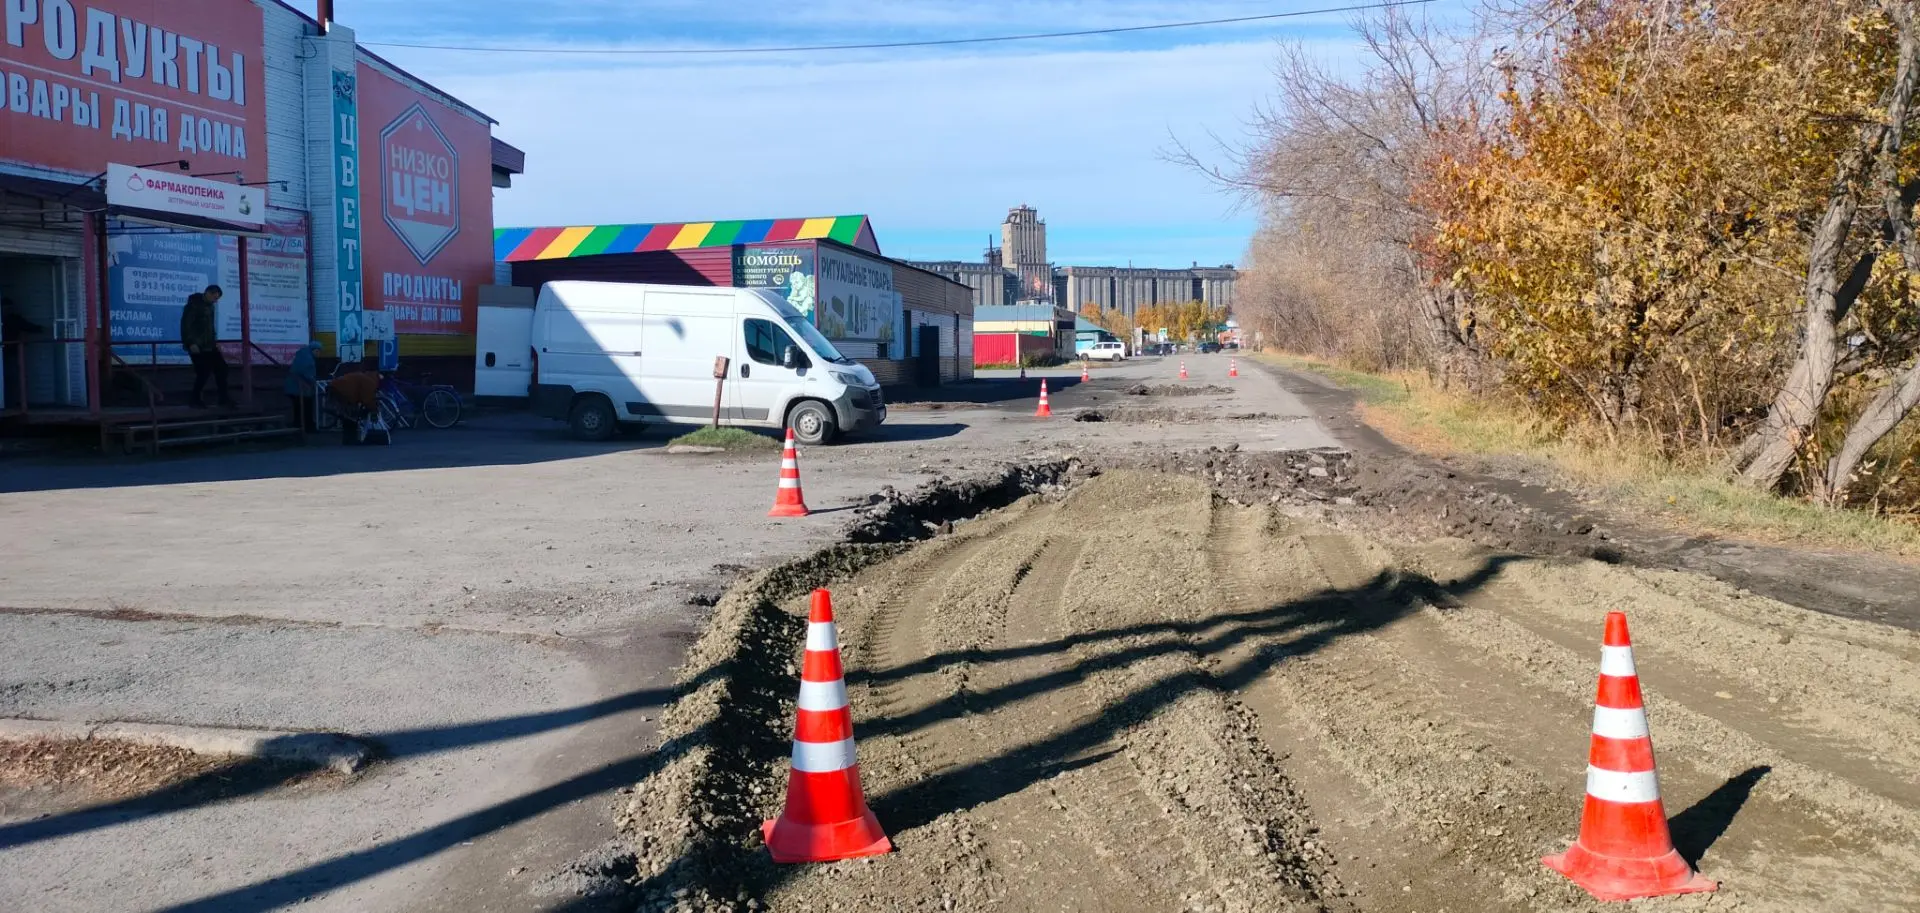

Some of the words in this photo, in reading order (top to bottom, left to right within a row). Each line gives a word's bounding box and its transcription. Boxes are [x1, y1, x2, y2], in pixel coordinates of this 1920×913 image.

[111, 98, 169, 144] ДЛЯ
[178, 112, 247, 159] ДОМА
[391, 143, 449, 180] НИЗКО
[391, 170, 450, 216] ЦЕН
[340, 112, 361, 312] ЦВЕТЫ
[383, 271, 462, 302] ПРОДУКТЫ
[109, 309, 153, 322] РЕКЛАМА
[109, 325, 124, 337] НА
[126, 326, 165, 339] ФАСАДЕ
